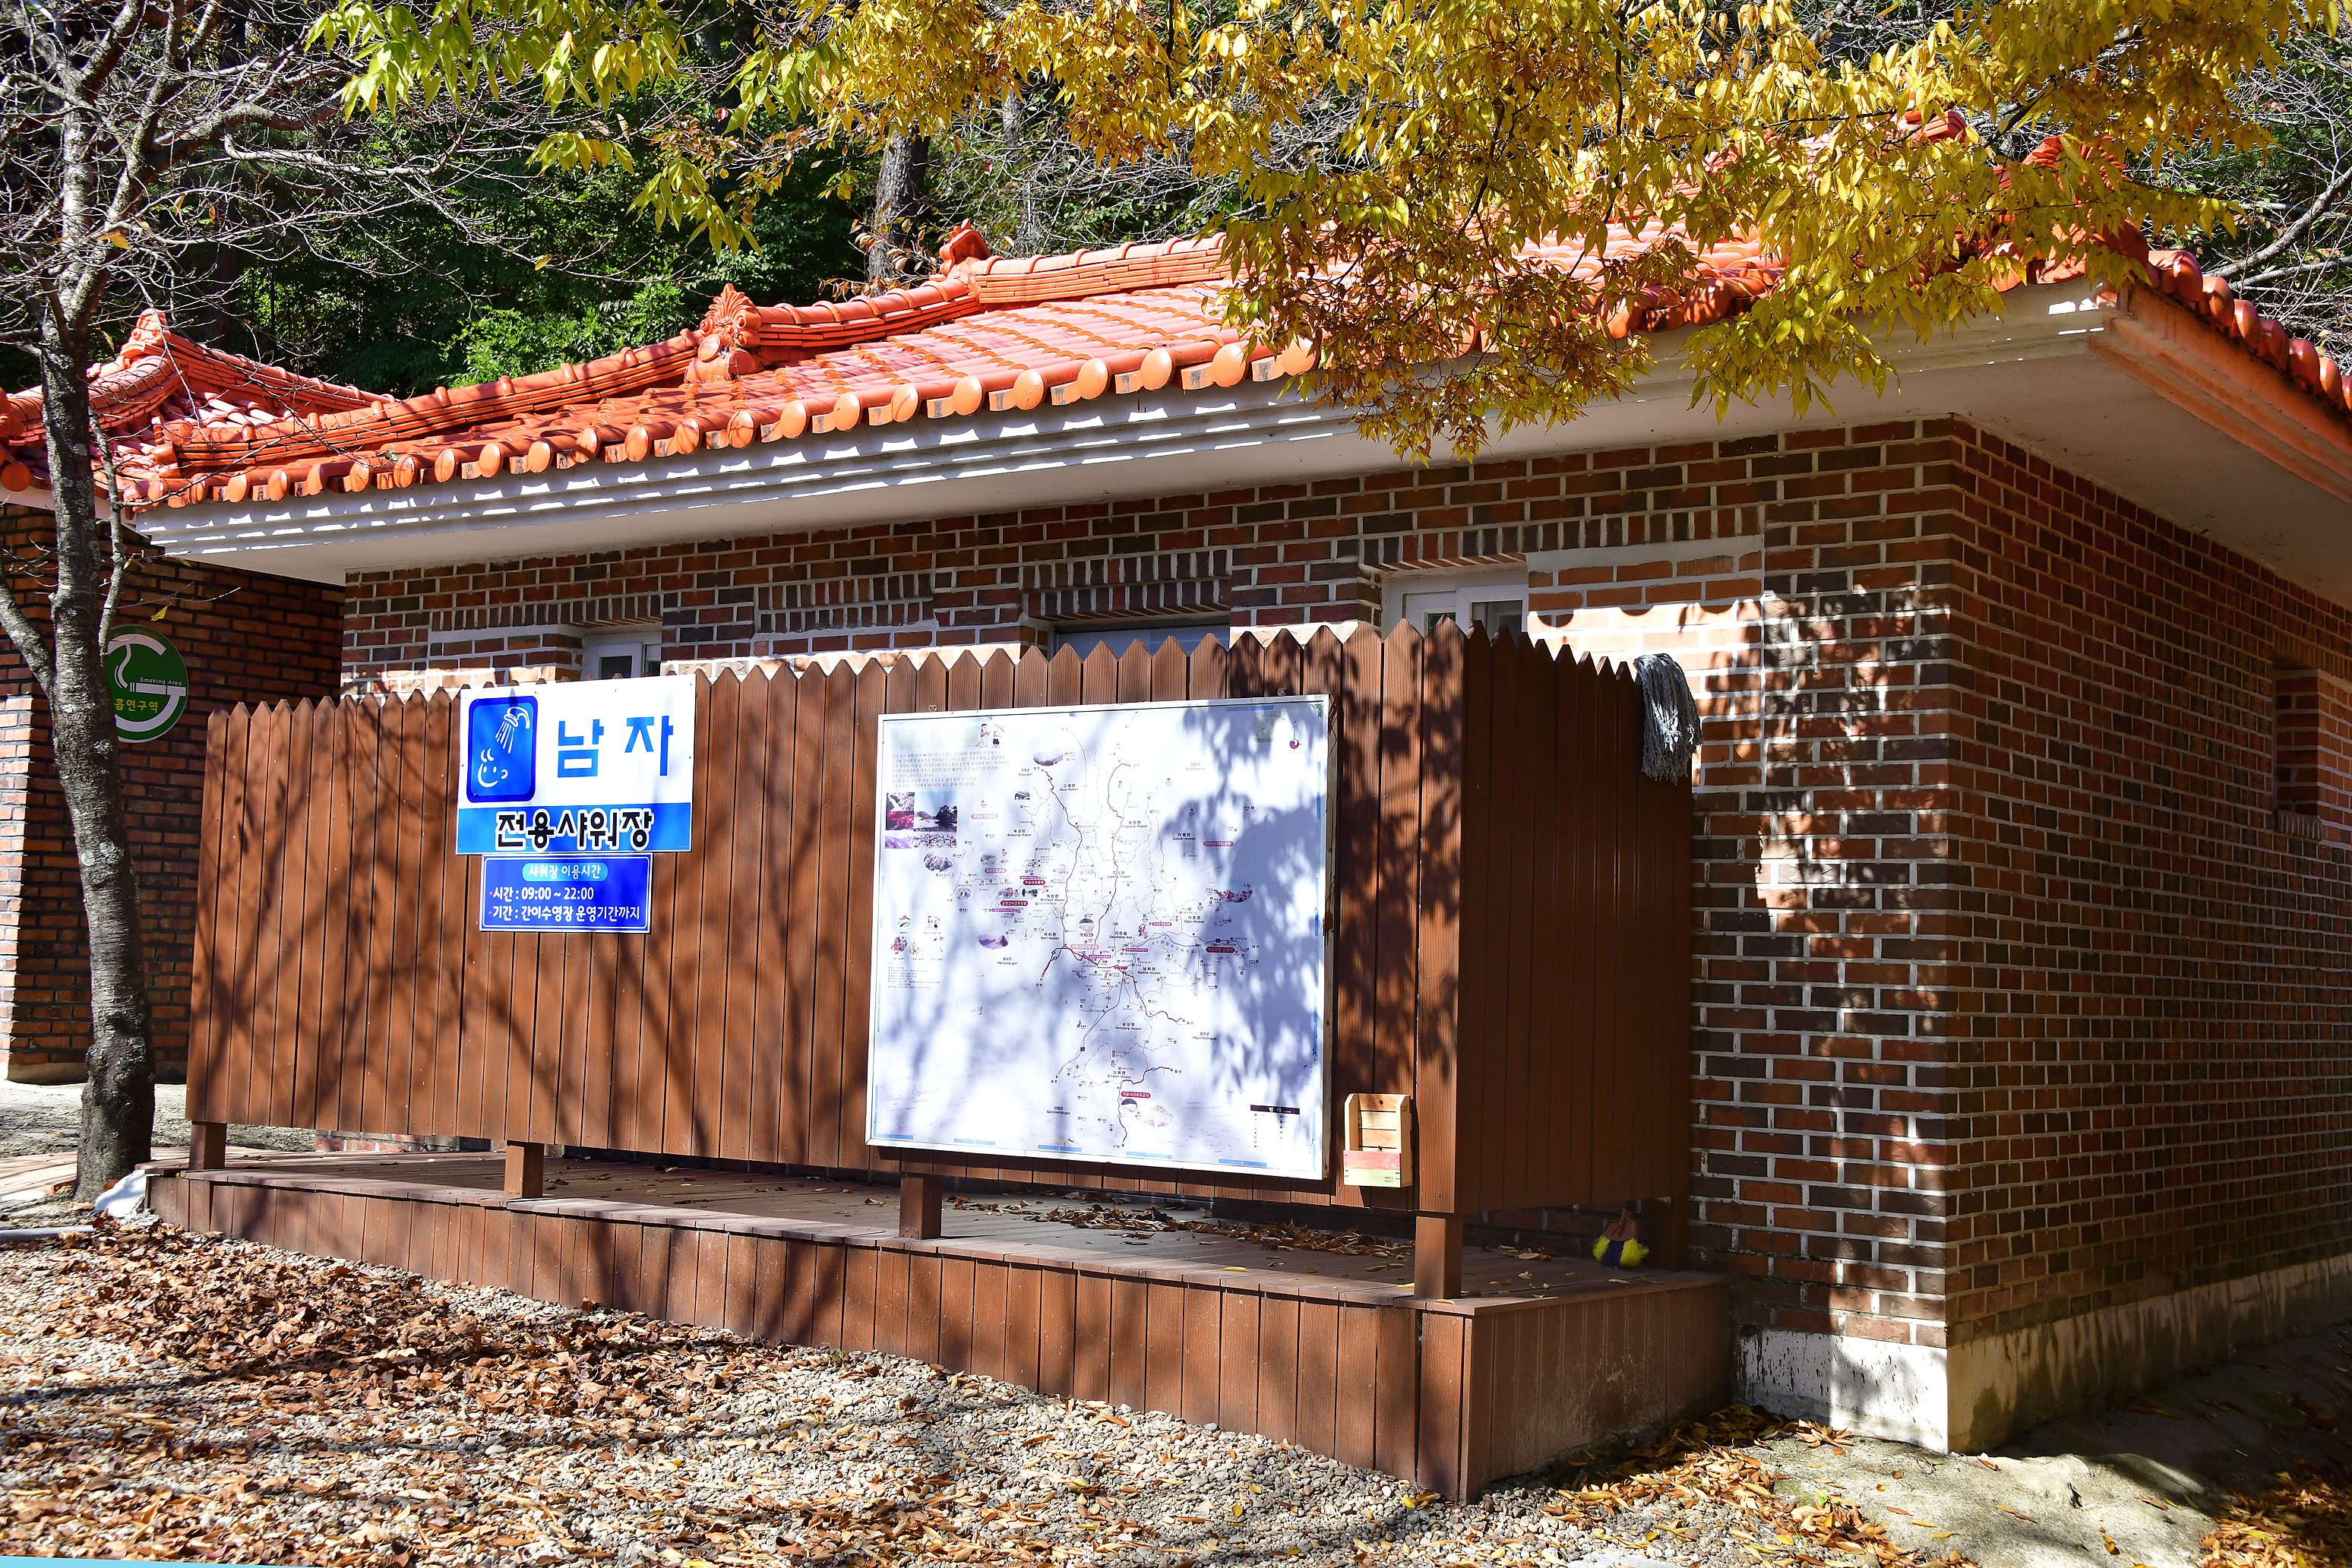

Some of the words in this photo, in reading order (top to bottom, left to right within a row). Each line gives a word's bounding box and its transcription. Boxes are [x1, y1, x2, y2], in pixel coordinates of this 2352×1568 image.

[140, 677, 166, 685] Smoking
[115, 698, 158, 713] 흡연구역
[558, 715, 674, 778] 남자
[497, 811, 653, 849] 전용샤워장
[529, 865, 558, 880] 샤워장
[561, 864, 602, 880] 이용시간
[521, 887, 552, 900] 09:00
[564, 887, 594, 900] 22:00
[521, 906, 574, 922] 간이수영장
[576, 906, 640, 922] 운영기간까지
